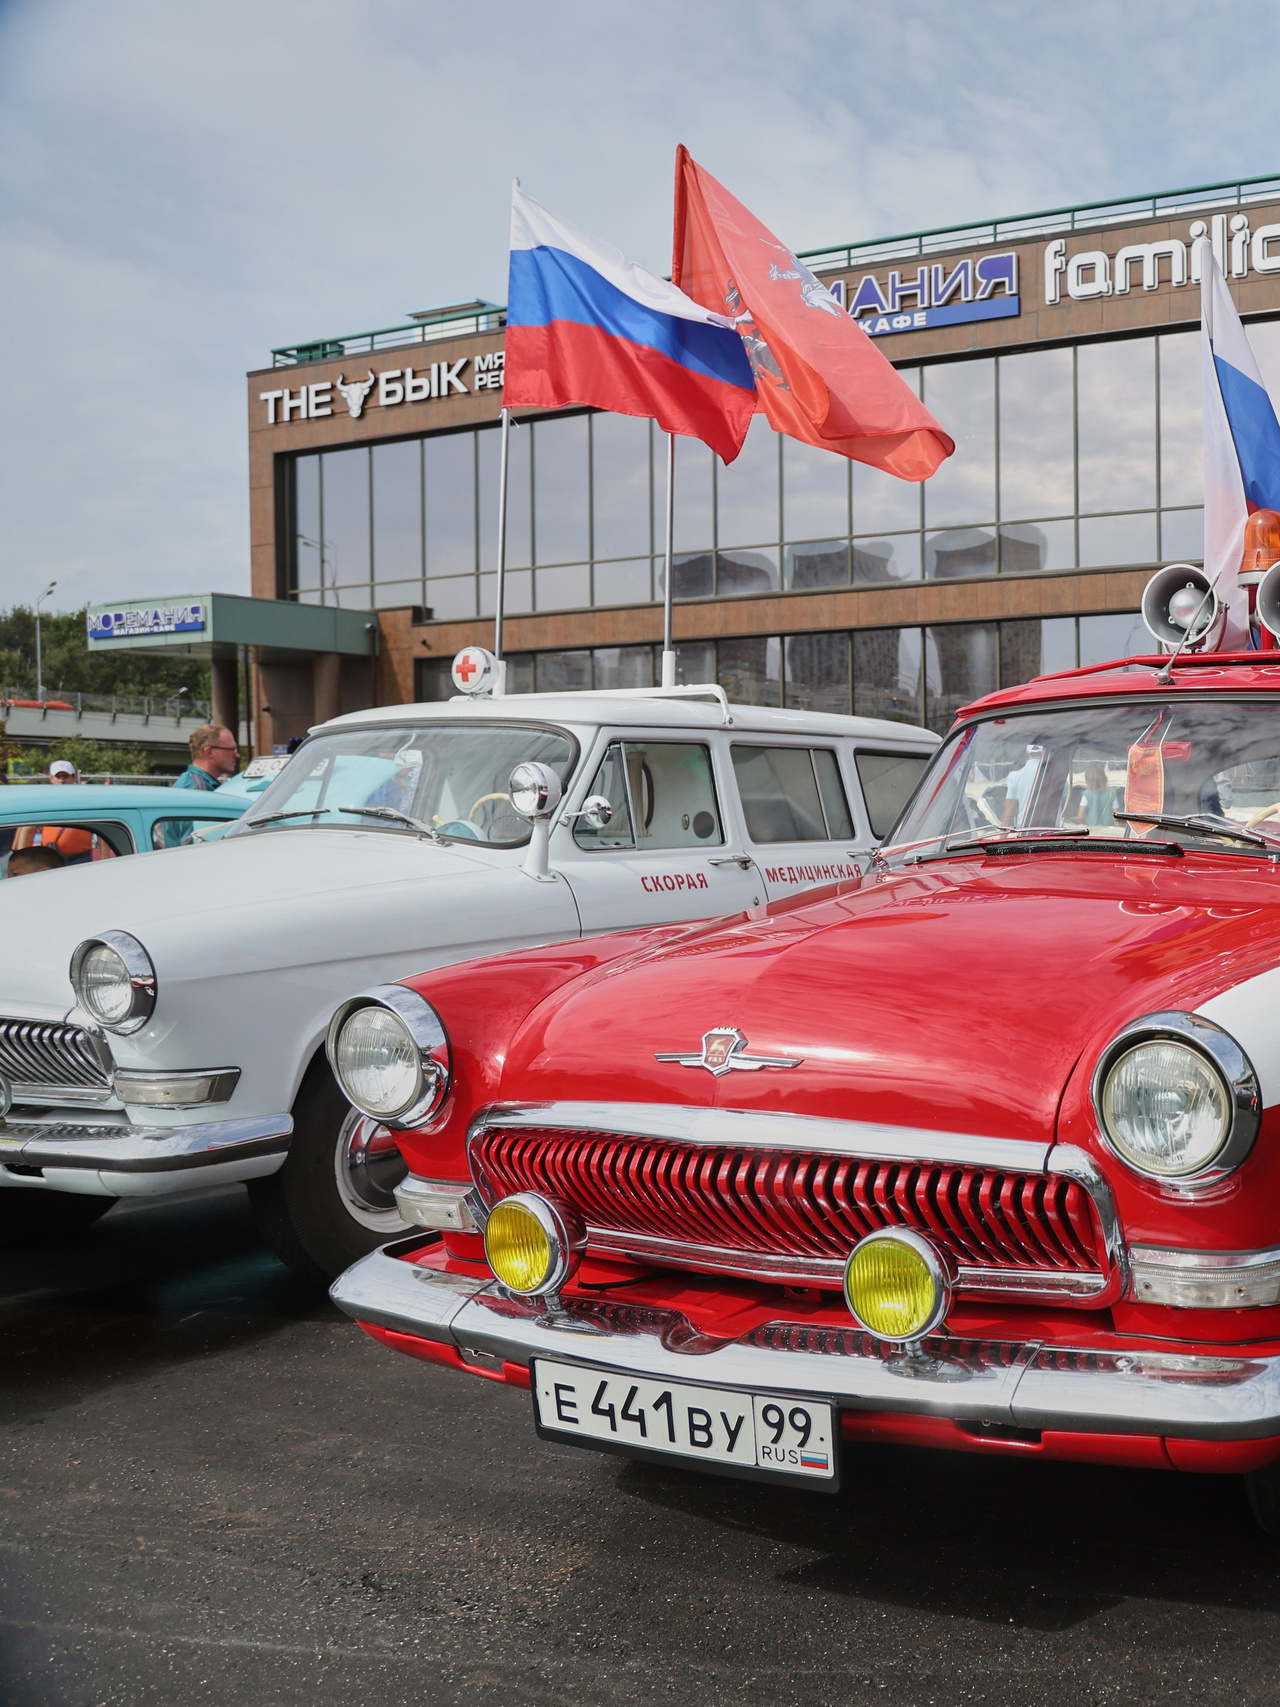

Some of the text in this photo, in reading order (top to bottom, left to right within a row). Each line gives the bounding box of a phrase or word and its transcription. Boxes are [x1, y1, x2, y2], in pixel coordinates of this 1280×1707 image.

[474, 351, 506, 372] МЯ
[378, 358, 469, 406] БЫК
[260, 381, 332, 424] THE
[87, 604, 204, 631] МОРЕМАНИЯ
[113, 624, 176, 636] МАГАЗИН-КАФЕ
[641, 863, 863, 893] СКОРАЯ МЕДИЦИНСКАЯ
[761, 1403, 812, 1448] 99
[762, 1445, 799, 1465] RUS
